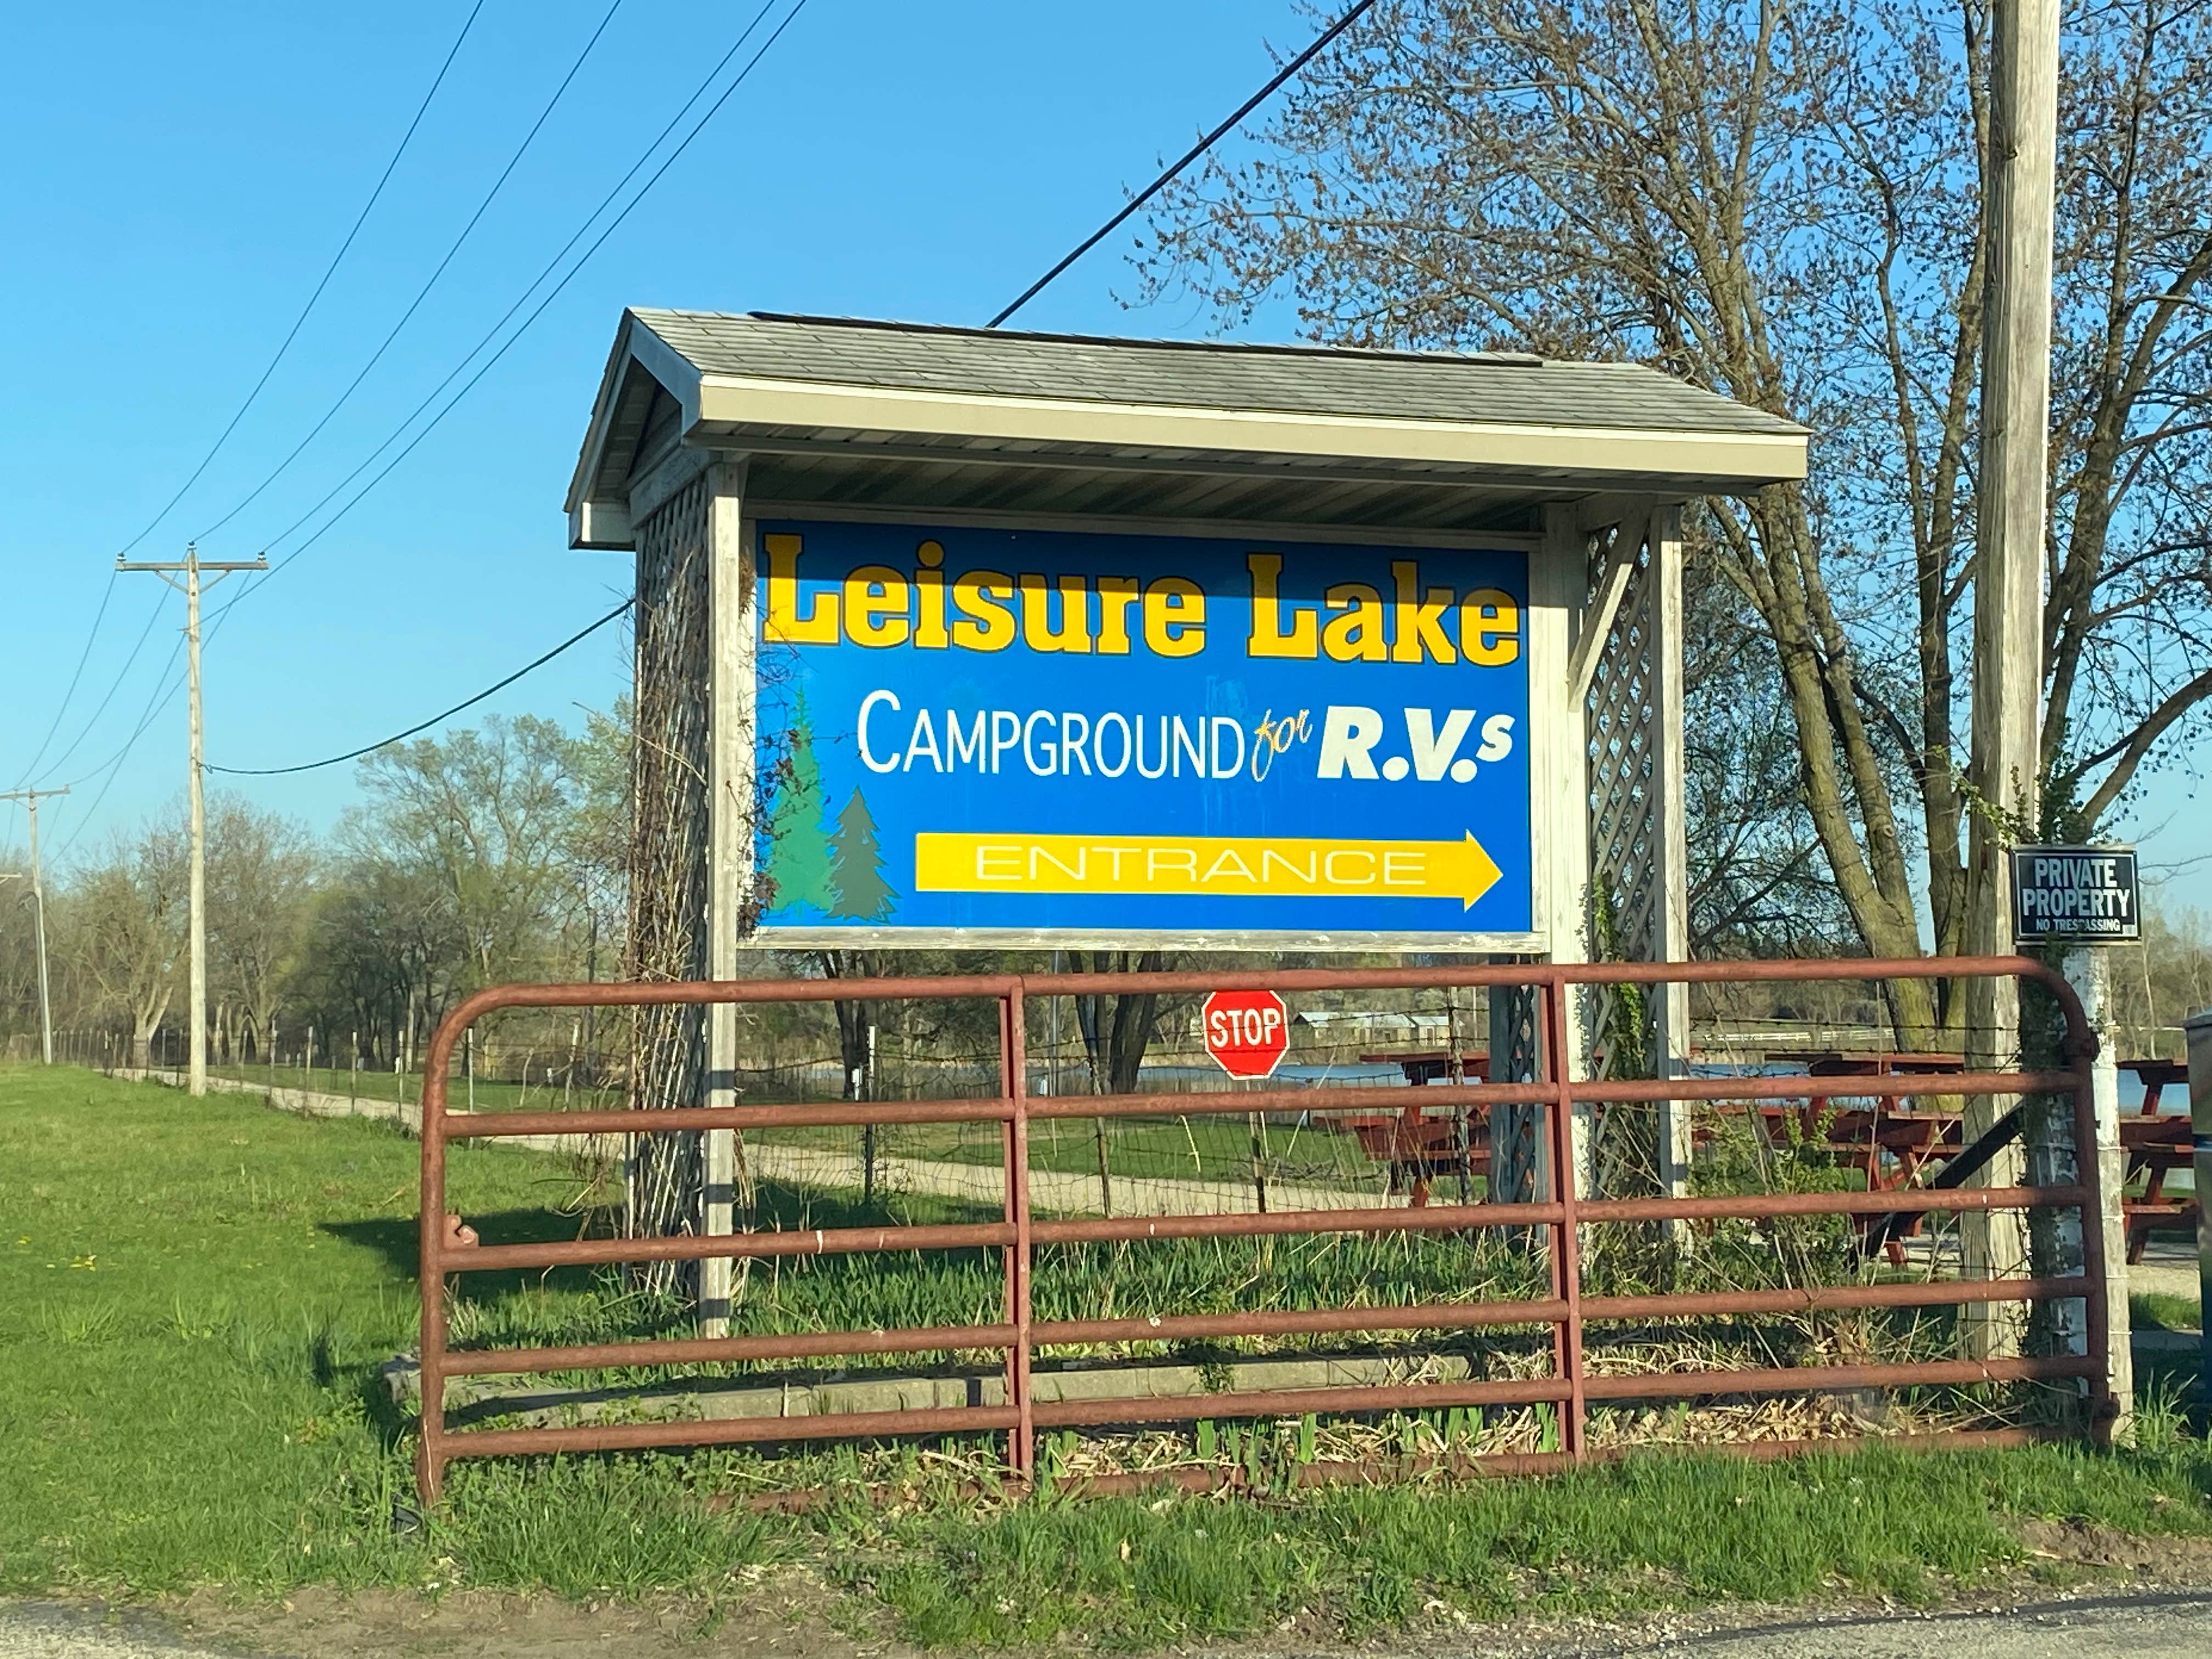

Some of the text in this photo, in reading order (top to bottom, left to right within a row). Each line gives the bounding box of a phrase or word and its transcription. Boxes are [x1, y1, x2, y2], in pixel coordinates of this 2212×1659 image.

[762, 533, 1520, 668] Leisure Lake
[857, 689, 1245, 779] CAMPGROUND
[1251, 708, 1314, 782] for
[976, 845, 1426, 885] ENTRANCE
[2034, 858, 2118, 888] PRIVATE
[2022, 888, 2130, 917] PROPERTY
[2036, 918, 2050, 932] NO
[1210, 1007, 1282, 1048] STOP
